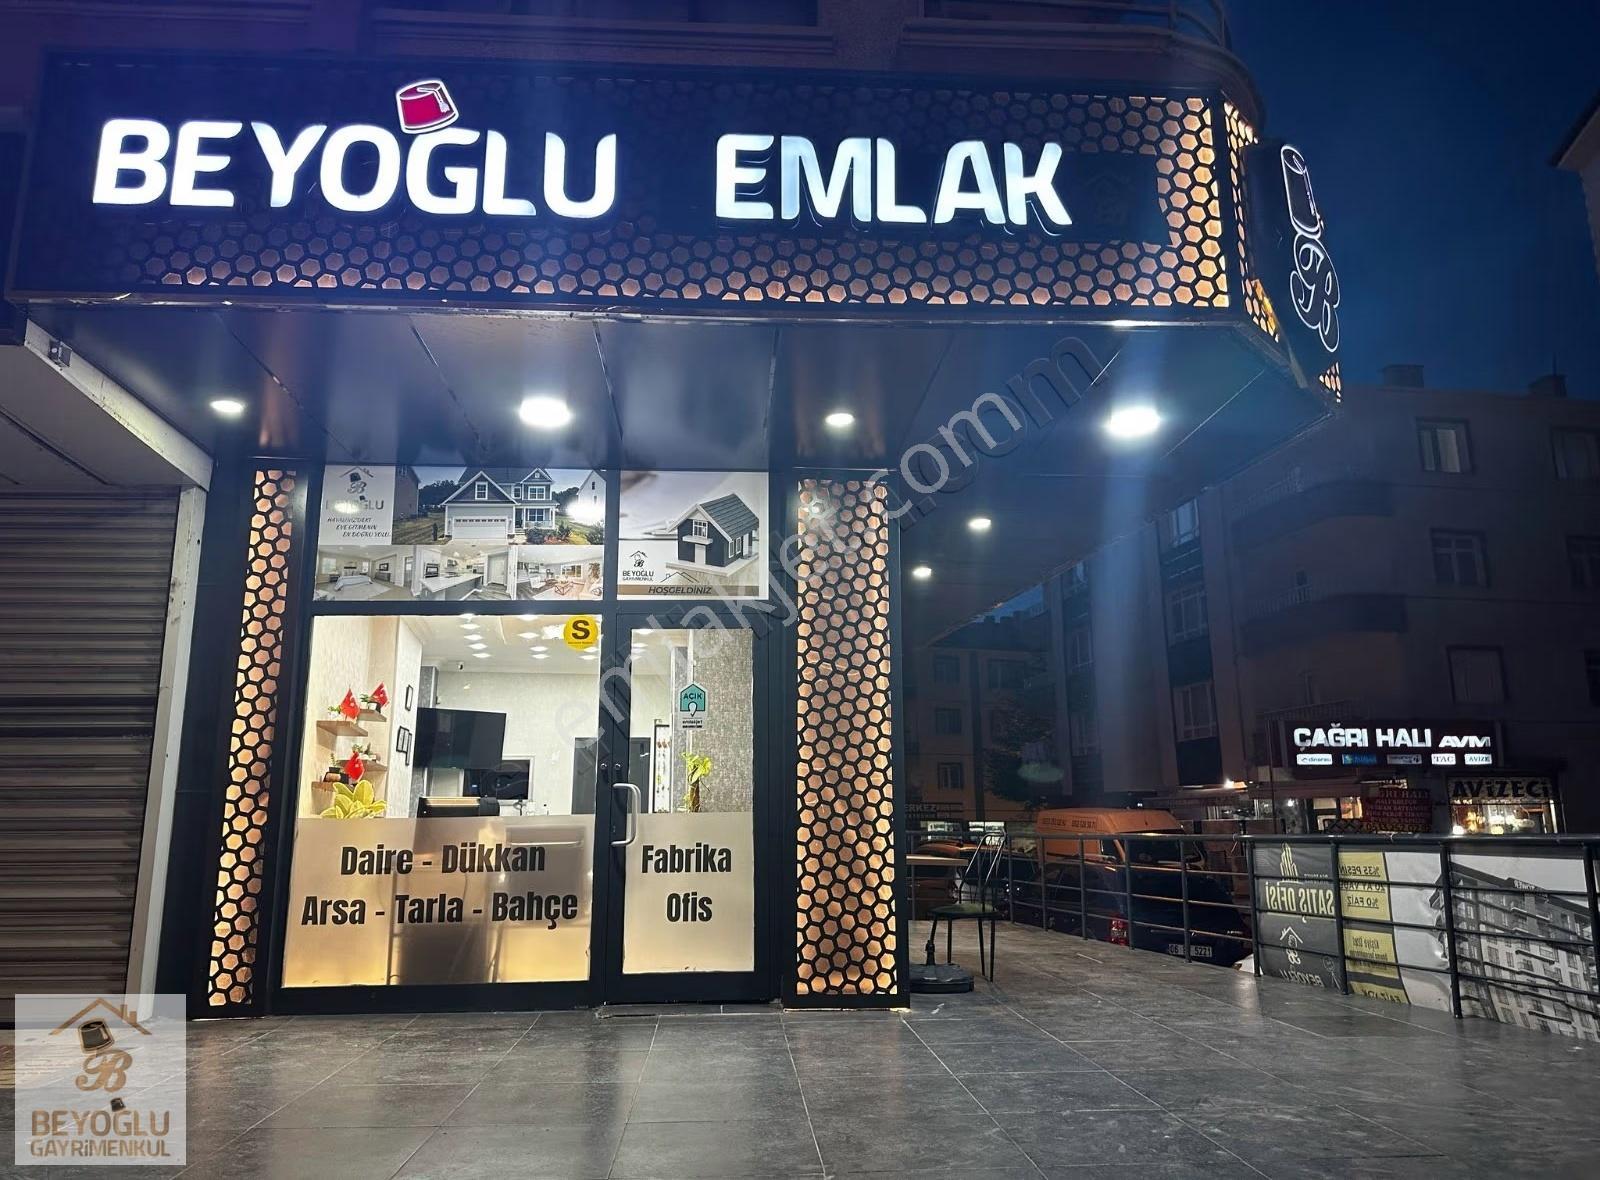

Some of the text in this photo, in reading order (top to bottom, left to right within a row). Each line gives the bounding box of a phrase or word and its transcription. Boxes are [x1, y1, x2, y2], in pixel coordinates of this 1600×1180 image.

[715, 133, 1073, 226] EMLAK
[572, 619, 591, 640] S
[683, 692, 703, 701] AÇIK
[1293, 723, 1491, 752] ÇAĞRI HALI AVM
[340, 844, 414, 875] Daire
[441, 842, 545, 873] Dükkan
[641, 842, 732, 874] Fabrika
[301, 895, 366, 925] Arsa
[395, 893, 464, 924] Tarla
[491, 891, 578, 930] Bahçe
[666, 891, 713, 922] Ofis
